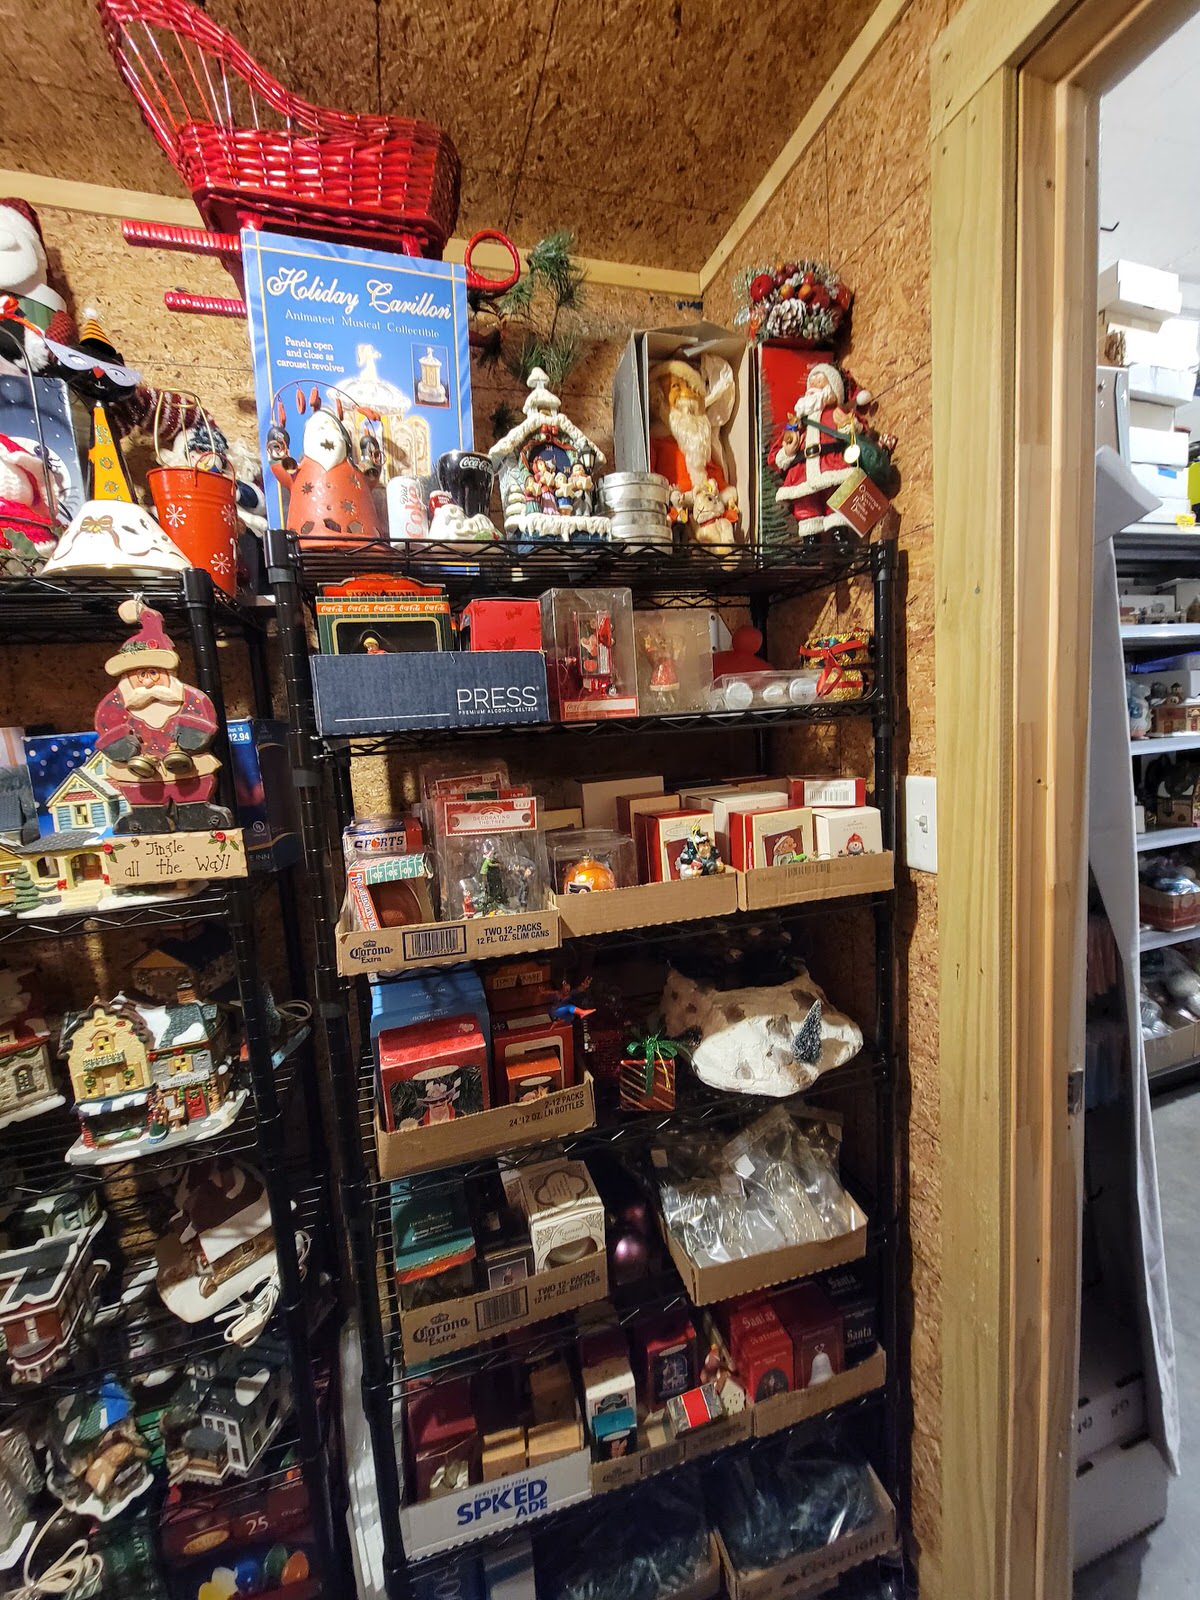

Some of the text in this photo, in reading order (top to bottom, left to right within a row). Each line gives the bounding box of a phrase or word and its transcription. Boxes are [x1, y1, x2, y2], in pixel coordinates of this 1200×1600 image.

[266, 266, 452, 320] Holiday Carillon
[285, 309, 440, 338] Animated Musical Collectible
[285, 336, 334, 352] Panels open
[286, 348, 334, 362] and close as
[276, 360, 344, 374] carousel revolves
[404, 486, 424, 538] Coke
[456, 686, 537, 710] PRESS
[228, 732, 250, 742] 12.94
[146, 840, 184, 857] Jingle
[124, 860, 140, 877] all
[156, 858, 182, 874] the
[484, 922, 542, 936] TWO 12-PACKS
[512, 932, 529, 940] SLIM
[531, 930, 550, 938] CANS
[350, 946, 391, 960] Corona
[545, 1090, 584, 1108] 2-12 PACKS
[544, 1109, 553, 1117] LN
[555, 1100, 584, 1114] BOTTLES
[537, 1270, 595, 1295] TWO 12-PACKS
[570, 1276, 600, 1291] BOTTLES
[413, 1318, 468, 1343] Corona
[430, 1333, 456, 1346] Extra
[516, 1496, 547, 1518] ADE
[246, 1515, 268, 1536] 25
